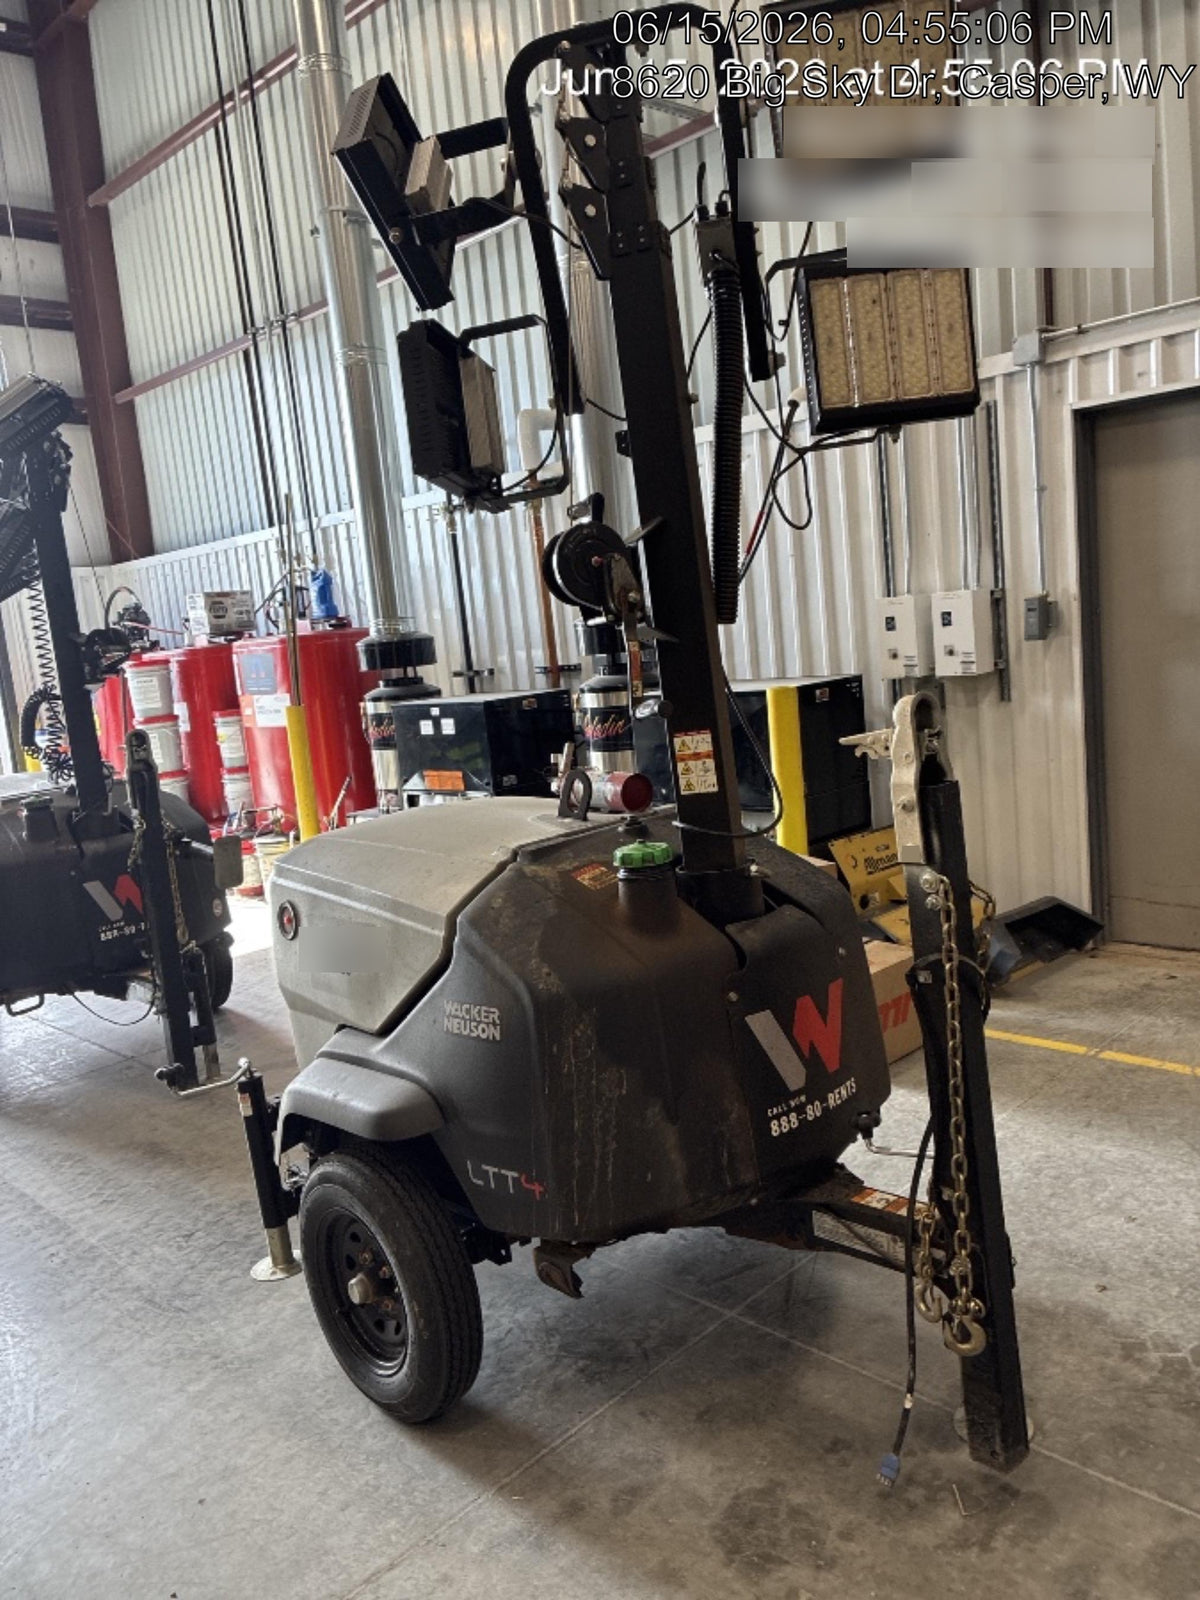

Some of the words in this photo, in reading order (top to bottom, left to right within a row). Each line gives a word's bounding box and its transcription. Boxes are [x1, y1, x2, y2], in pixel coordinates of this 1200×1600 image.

[443, 1000, 501, 1024] WACKER
[443, 1016, 501, 1041] NEUSON
[466, 1160, 545, 1201] LTT4
